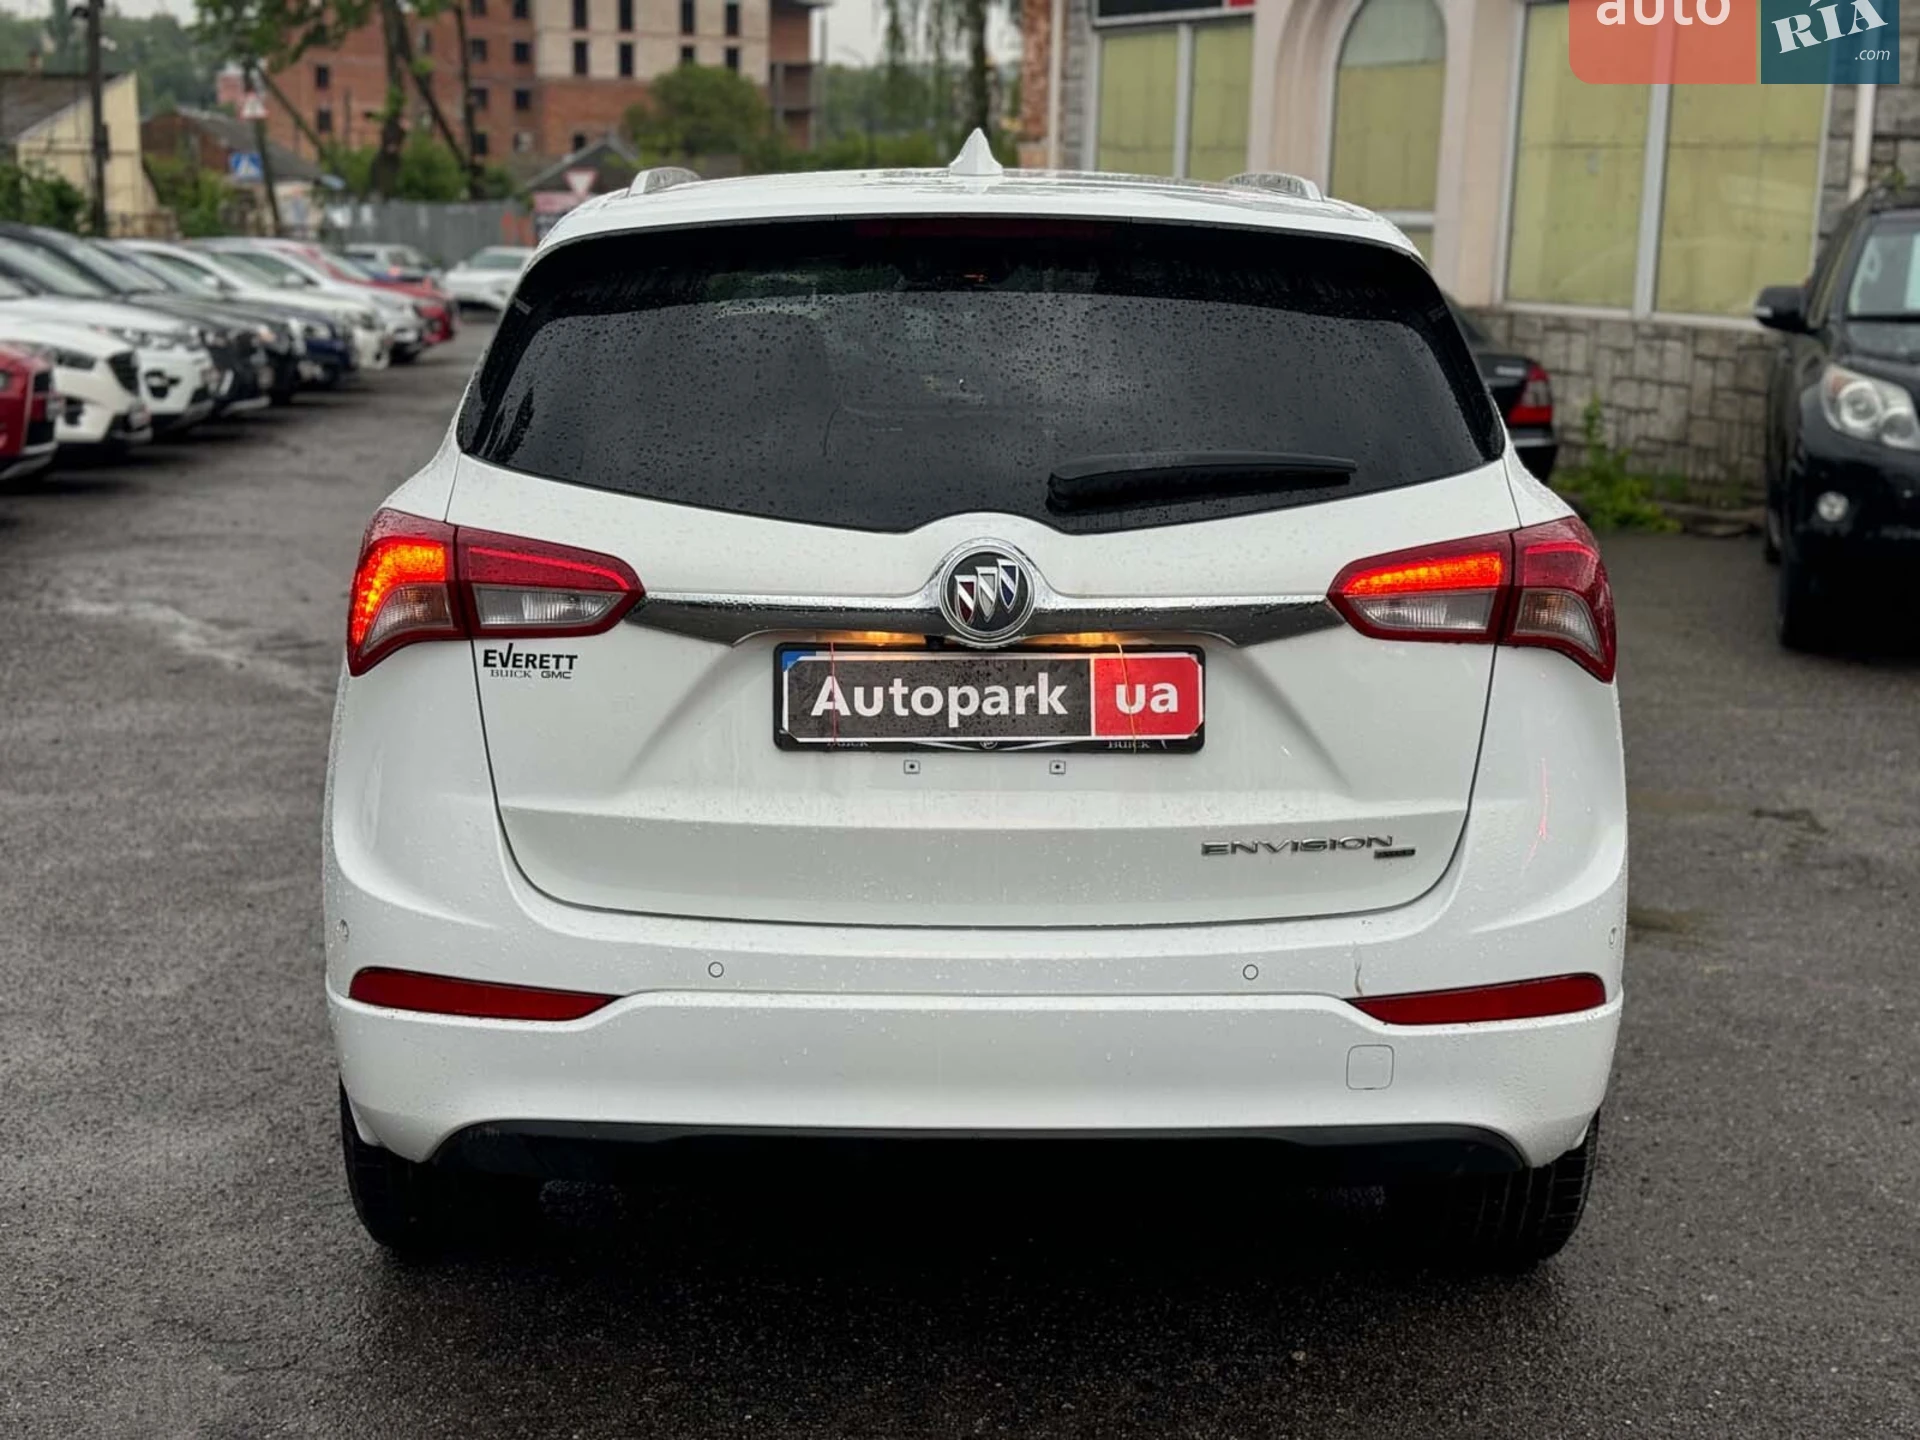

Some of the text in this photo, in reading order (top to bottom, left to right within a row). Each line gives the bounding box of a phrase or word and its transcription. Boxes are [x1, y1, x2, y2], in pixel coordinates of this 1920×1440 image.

[490, 669, 572, 680] BUICK GMC
[811, 672, 1179, 728] Autopark ua
[1201, 835, 1393, 856] ENVISION
